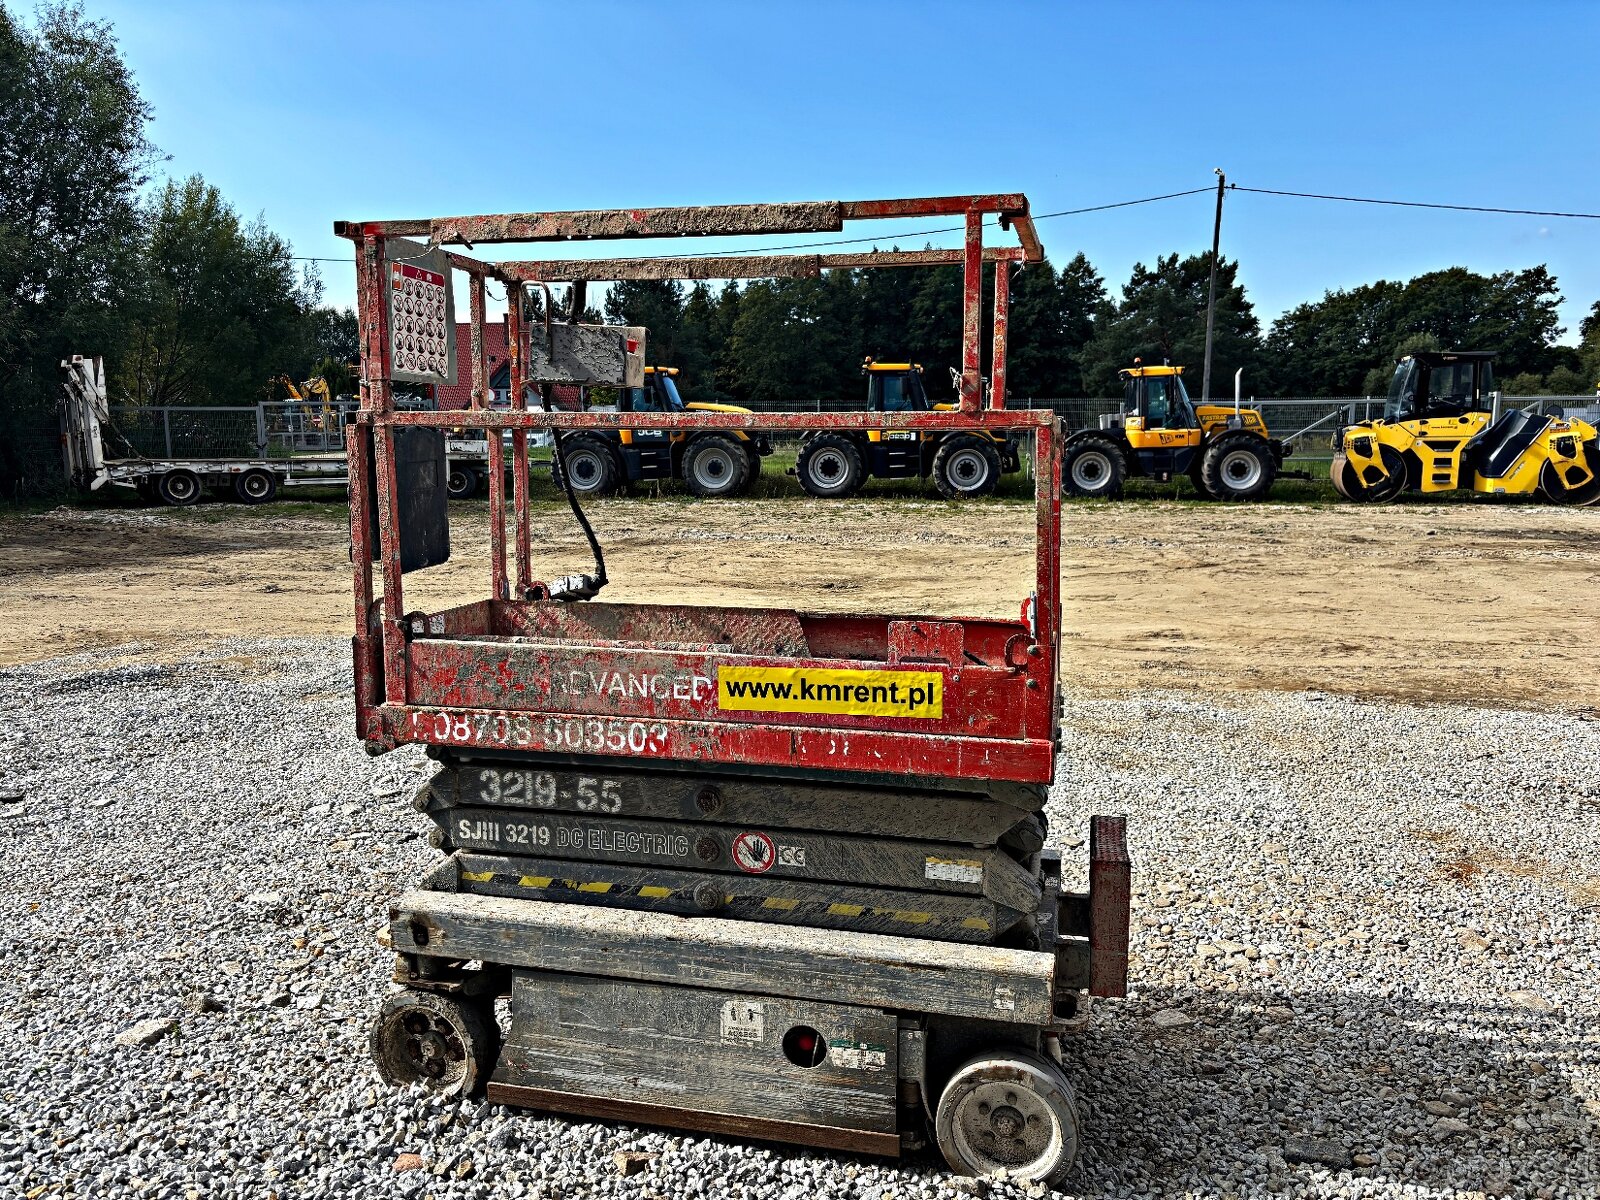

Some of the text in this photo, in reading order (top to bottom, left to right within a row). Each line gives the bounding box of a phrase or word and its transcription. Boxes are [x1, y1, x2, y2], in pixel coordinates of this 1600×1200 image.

[556, 670, 713, 700] DVANCED
[725, 677, 934, 710] www.kmrent.pl
[505, 823, 550, 846] 3219
[556, 826, 584, 849] DC
[588, 829, 689, 858] ELECTRIC
